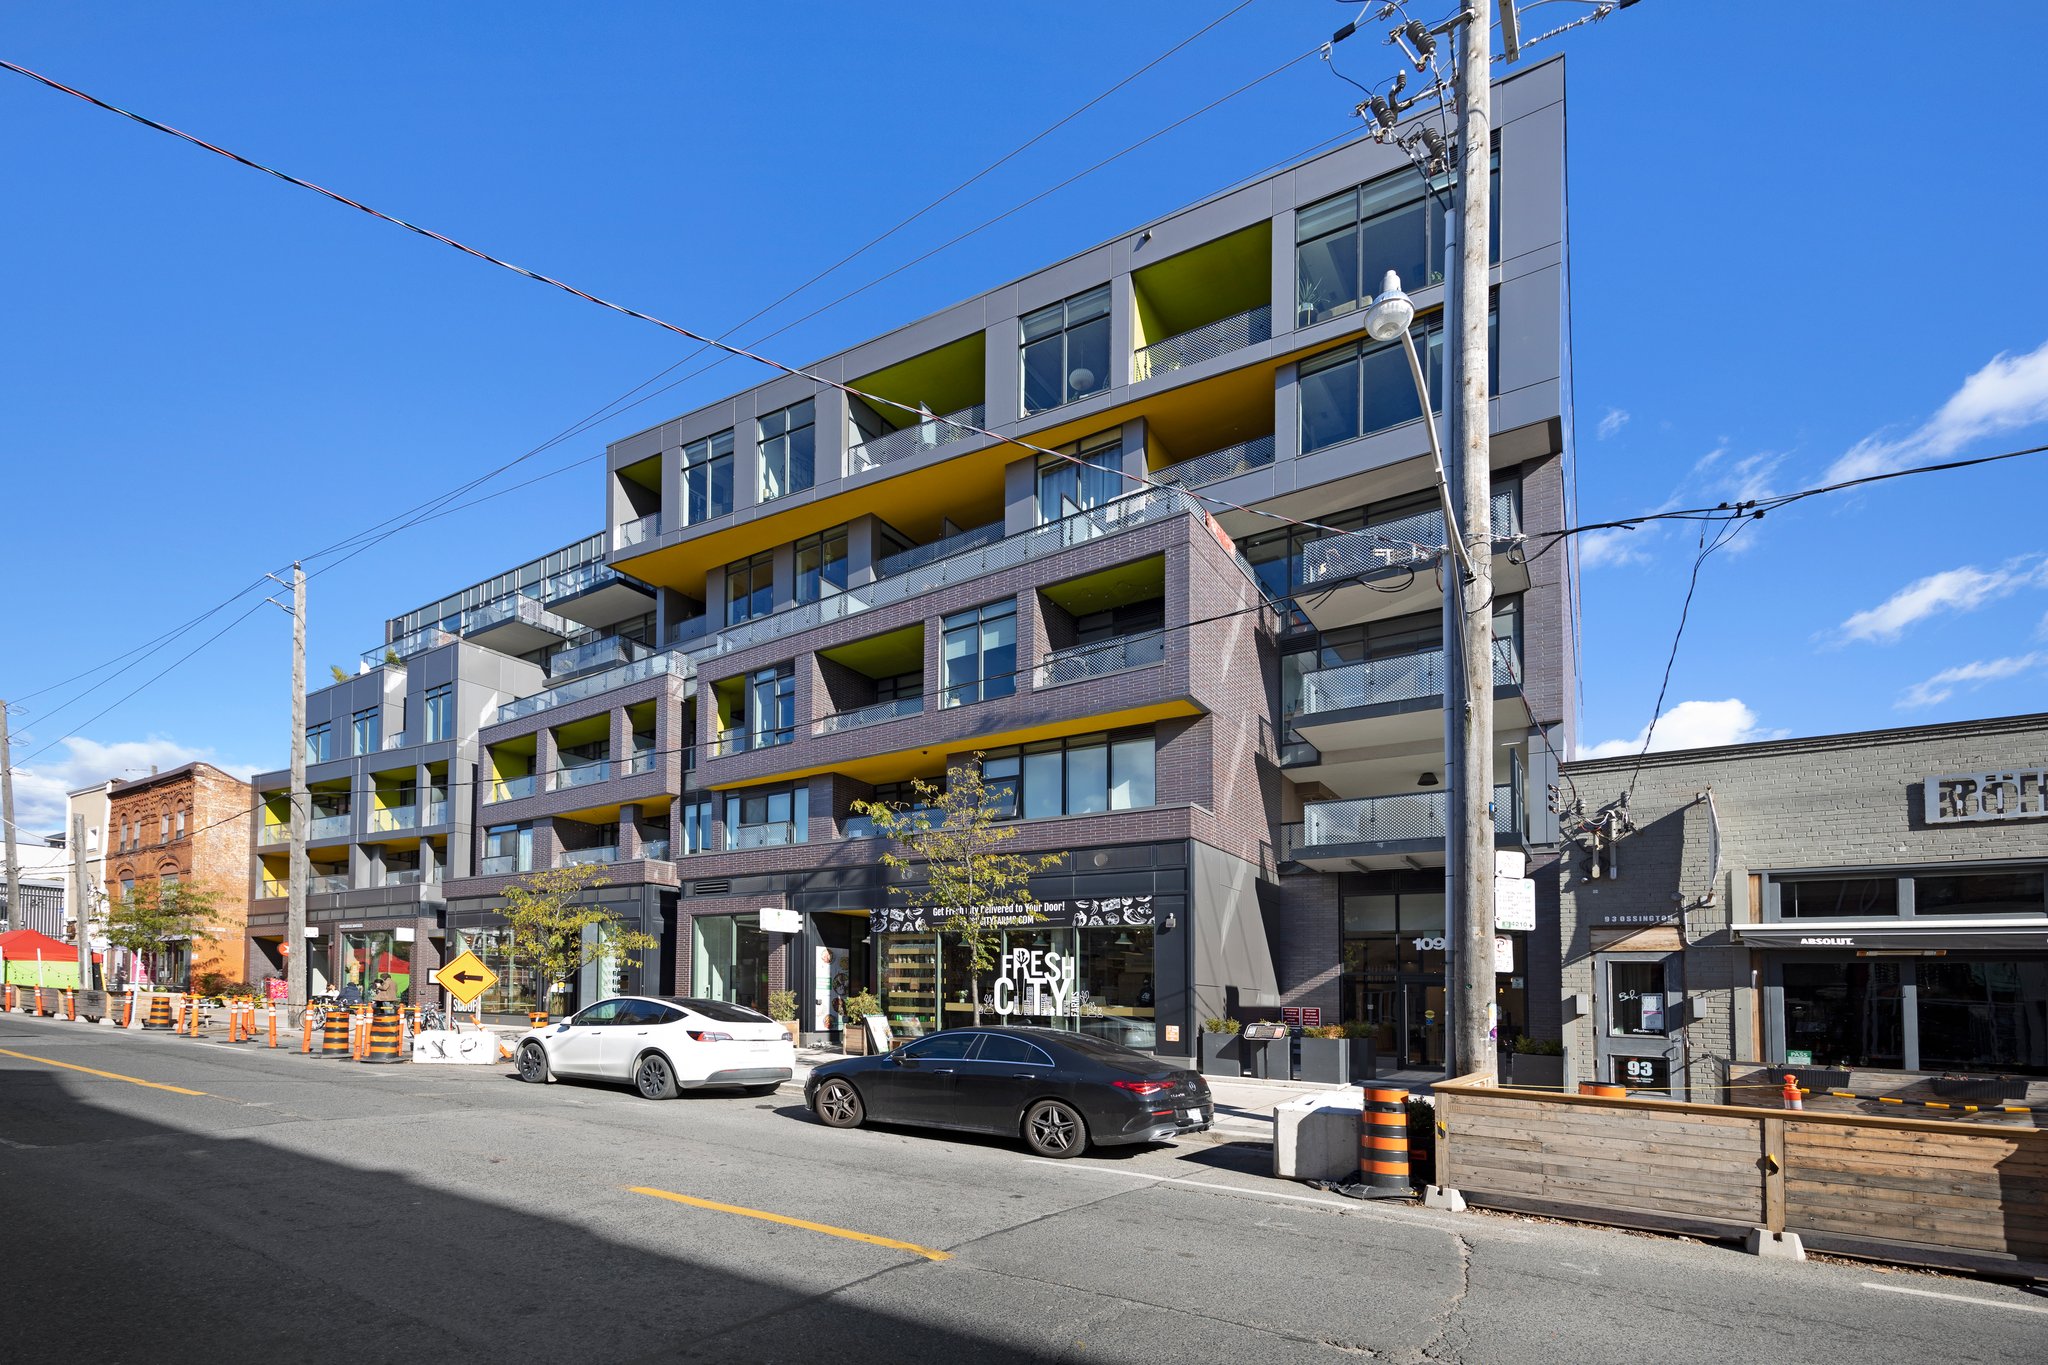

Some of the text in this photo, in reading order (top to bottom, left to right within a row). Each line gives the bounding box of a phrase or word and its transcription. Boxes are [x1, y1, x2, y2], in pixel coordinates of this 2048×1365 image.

[933, 907, 944, 917] Get
[1015, 903, 1023, 912] to
[1025, 902, 1042, 912] Your
[1044, 901, 1065, 911] Door!
[1604, 915, 1617, 923] 93
[1412, 937, 1446, 951] 109
[1800, 937, 1855, 946] ABSOLUT.
[1002, 947, 1075, 982] FRESH
[994, 977, 1072, 1017] CITY
[1070, 991, 1080, 1017] FARMS
[1627, 1060, 1653, 1077] 93
